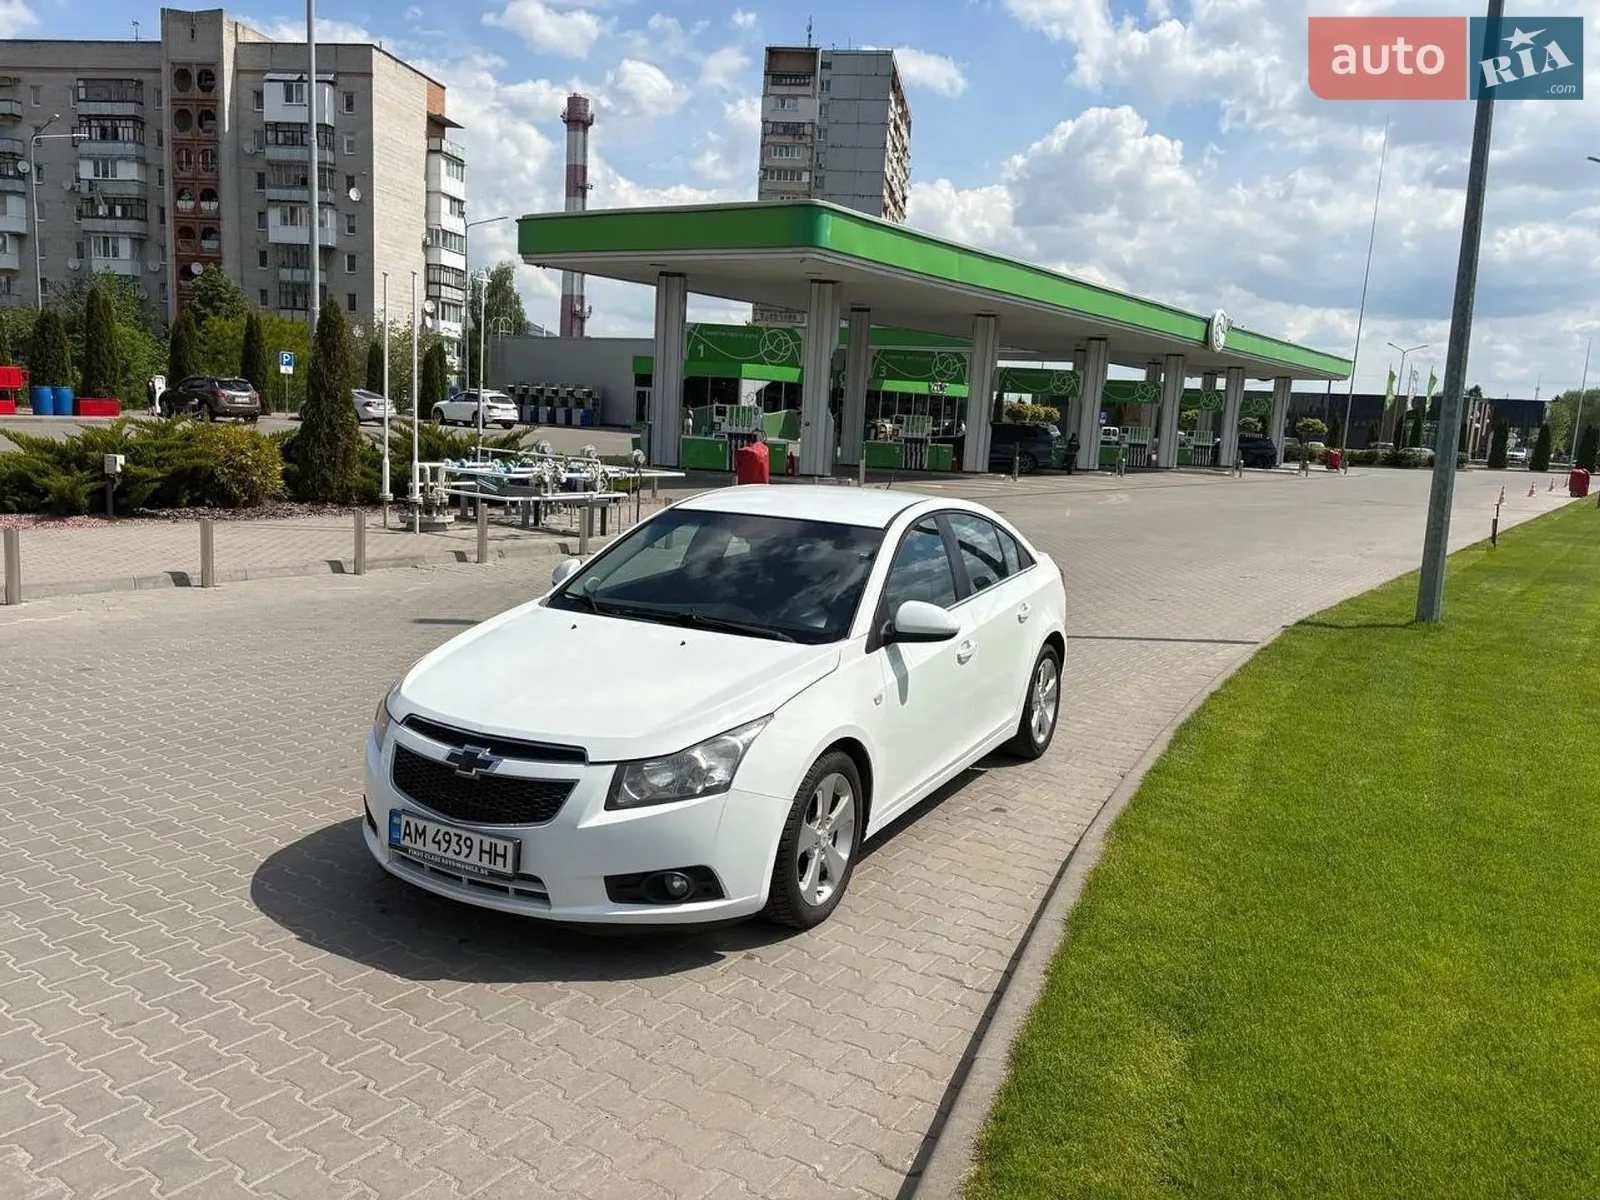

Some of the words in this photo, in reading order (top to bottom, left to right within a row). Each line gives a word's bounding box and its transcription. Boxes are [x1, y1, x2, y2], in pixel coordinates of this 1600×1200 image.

[698, 343, 705, 358] 1
[283, 353, 291, 365] P
[402, 820, 427, 847] AM
[431, 828, 474, 858] 4939
[479, 840, 508, 868] HH
